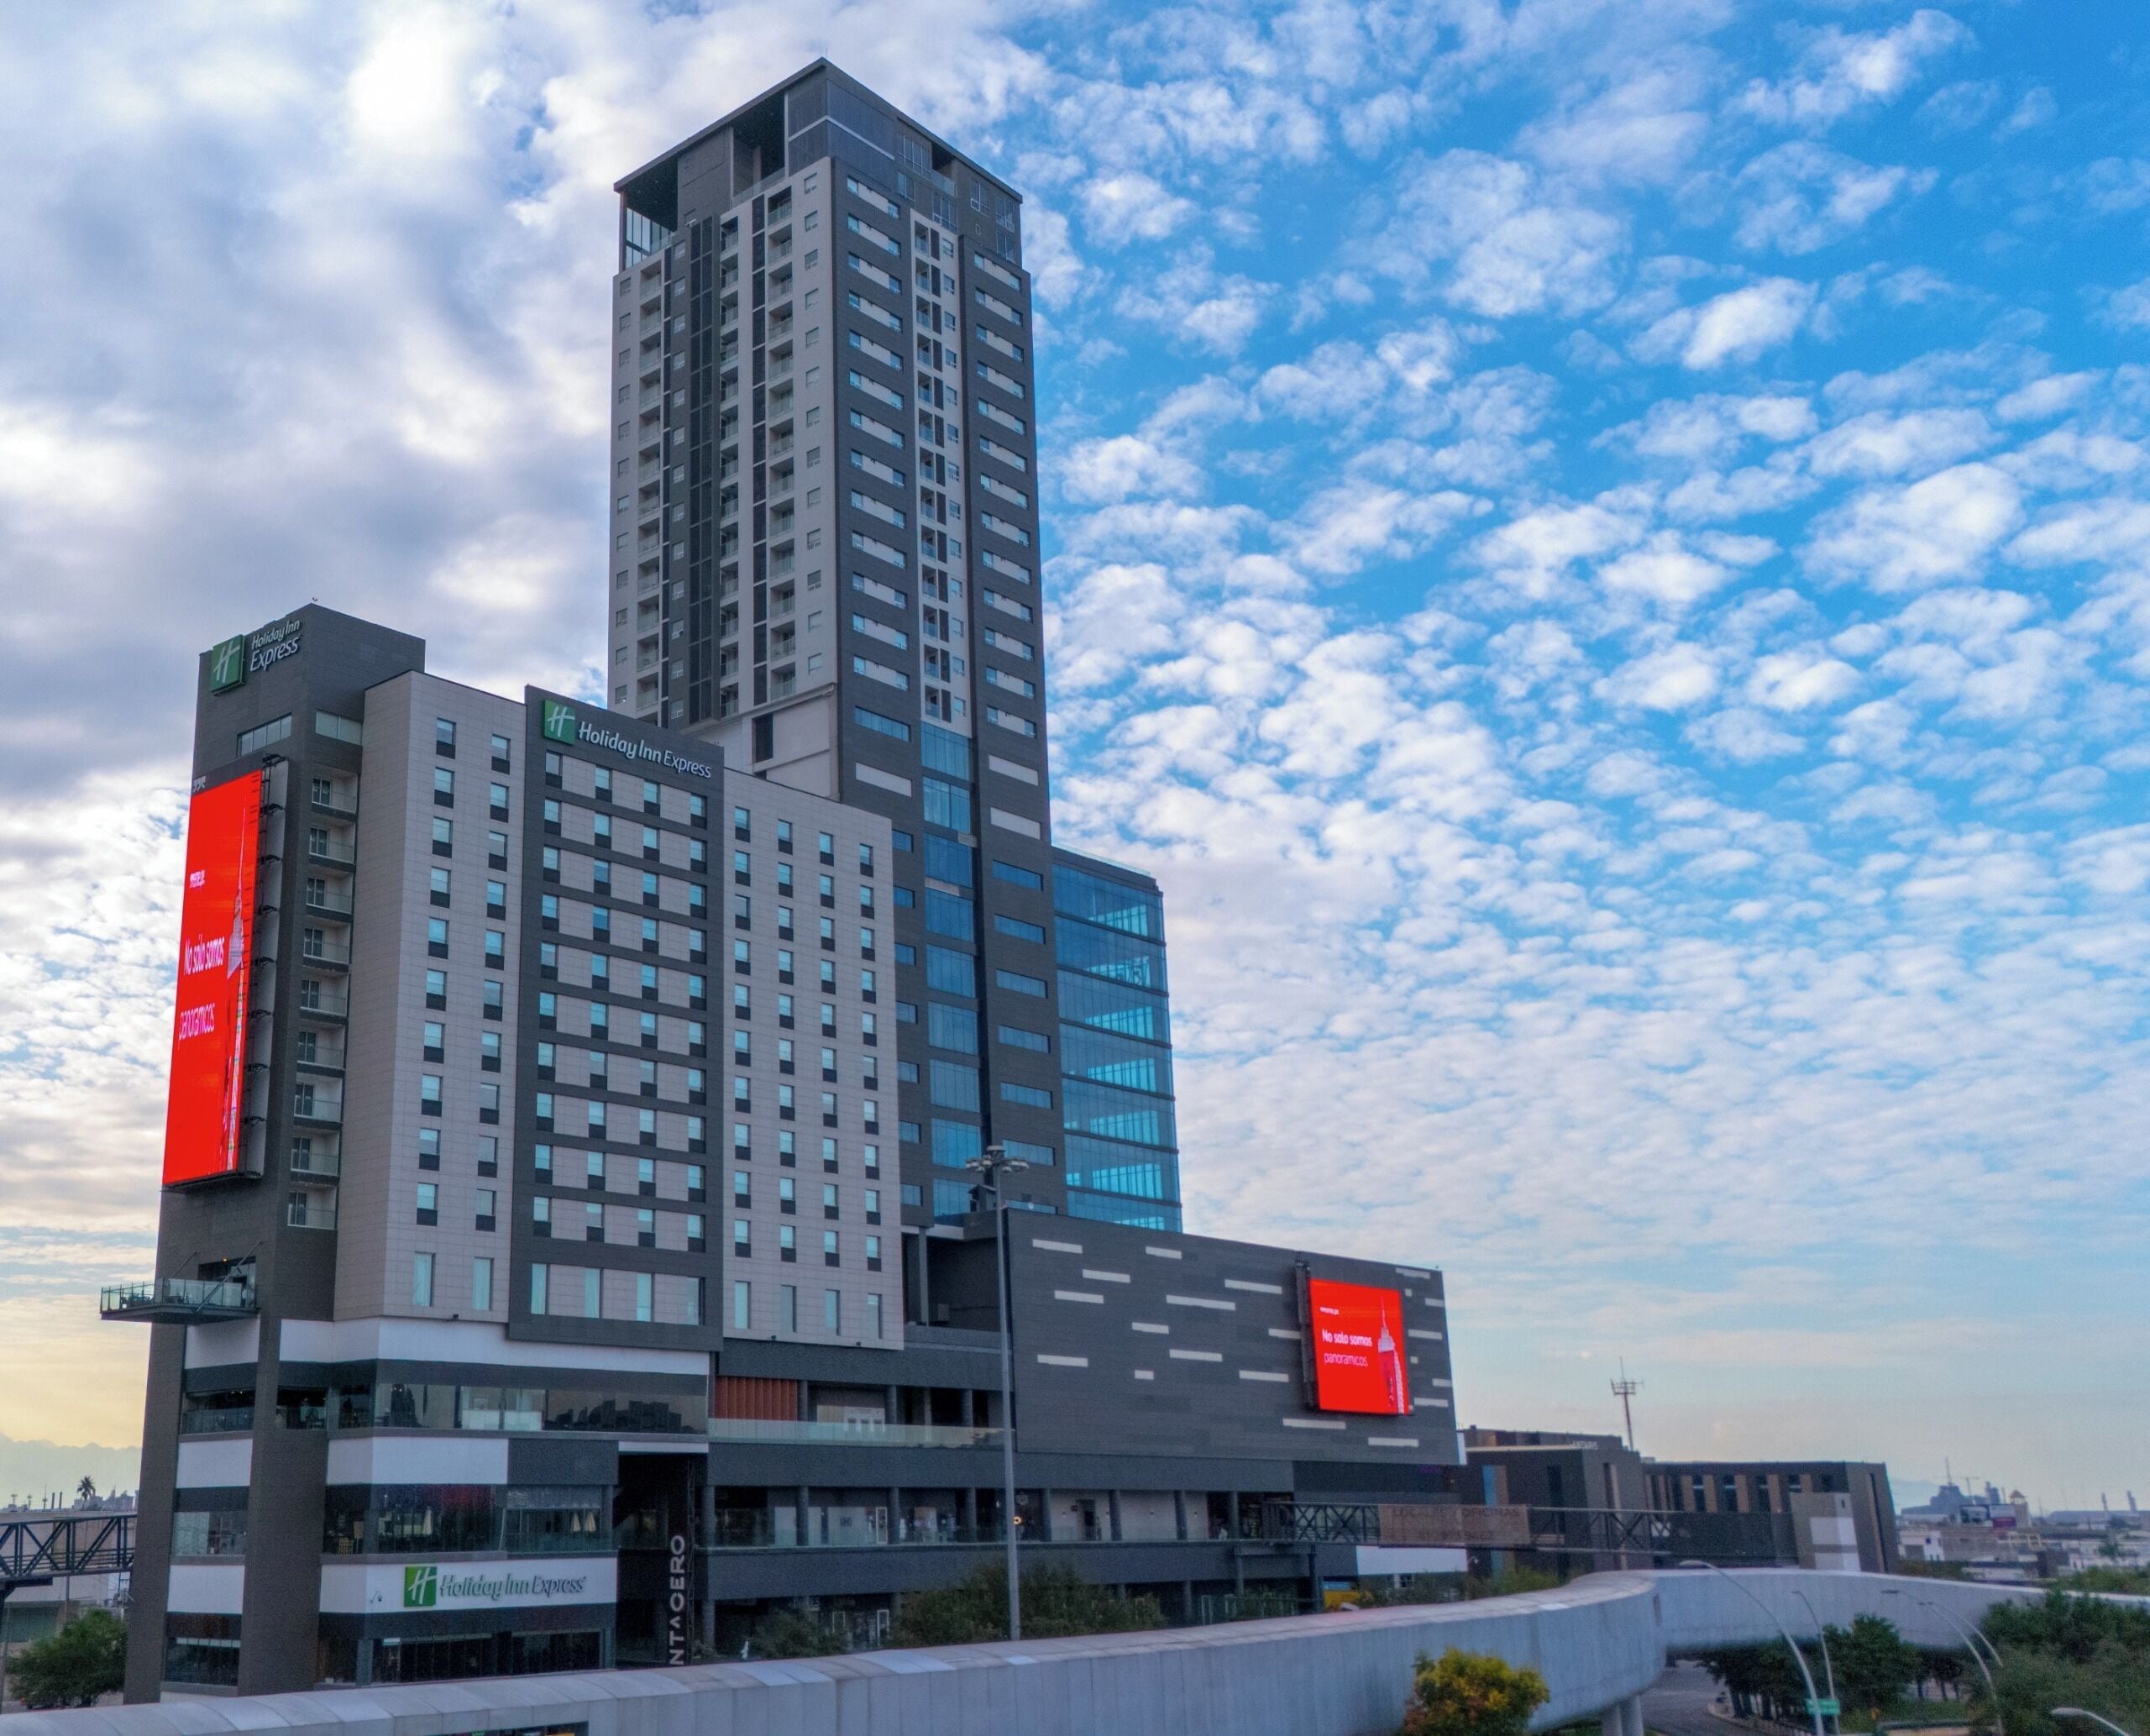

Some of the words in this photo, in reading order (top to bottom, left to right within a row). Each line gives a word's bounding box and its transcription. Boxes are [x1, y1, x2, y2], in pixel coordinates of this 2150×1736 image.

[251, 627, 285, 650] Holiday
[285, 620, 300, 635] Inn
[249, 636, 299, 672] Express
[578, 721, 637, 759] Holiday
[638, 739, 662, 763] Inn
[663, 749, 711, 779] Express
[205, 936, 225, 970] somos
[1321, 1329, 1333, 1344] No
[1349, 1335, 1373, 1347] somos
[440, 1574, 502, 1601] Holiday
[505, 1573, 529, 1595] Inn
[532, 1575, 585, 1597] Express
